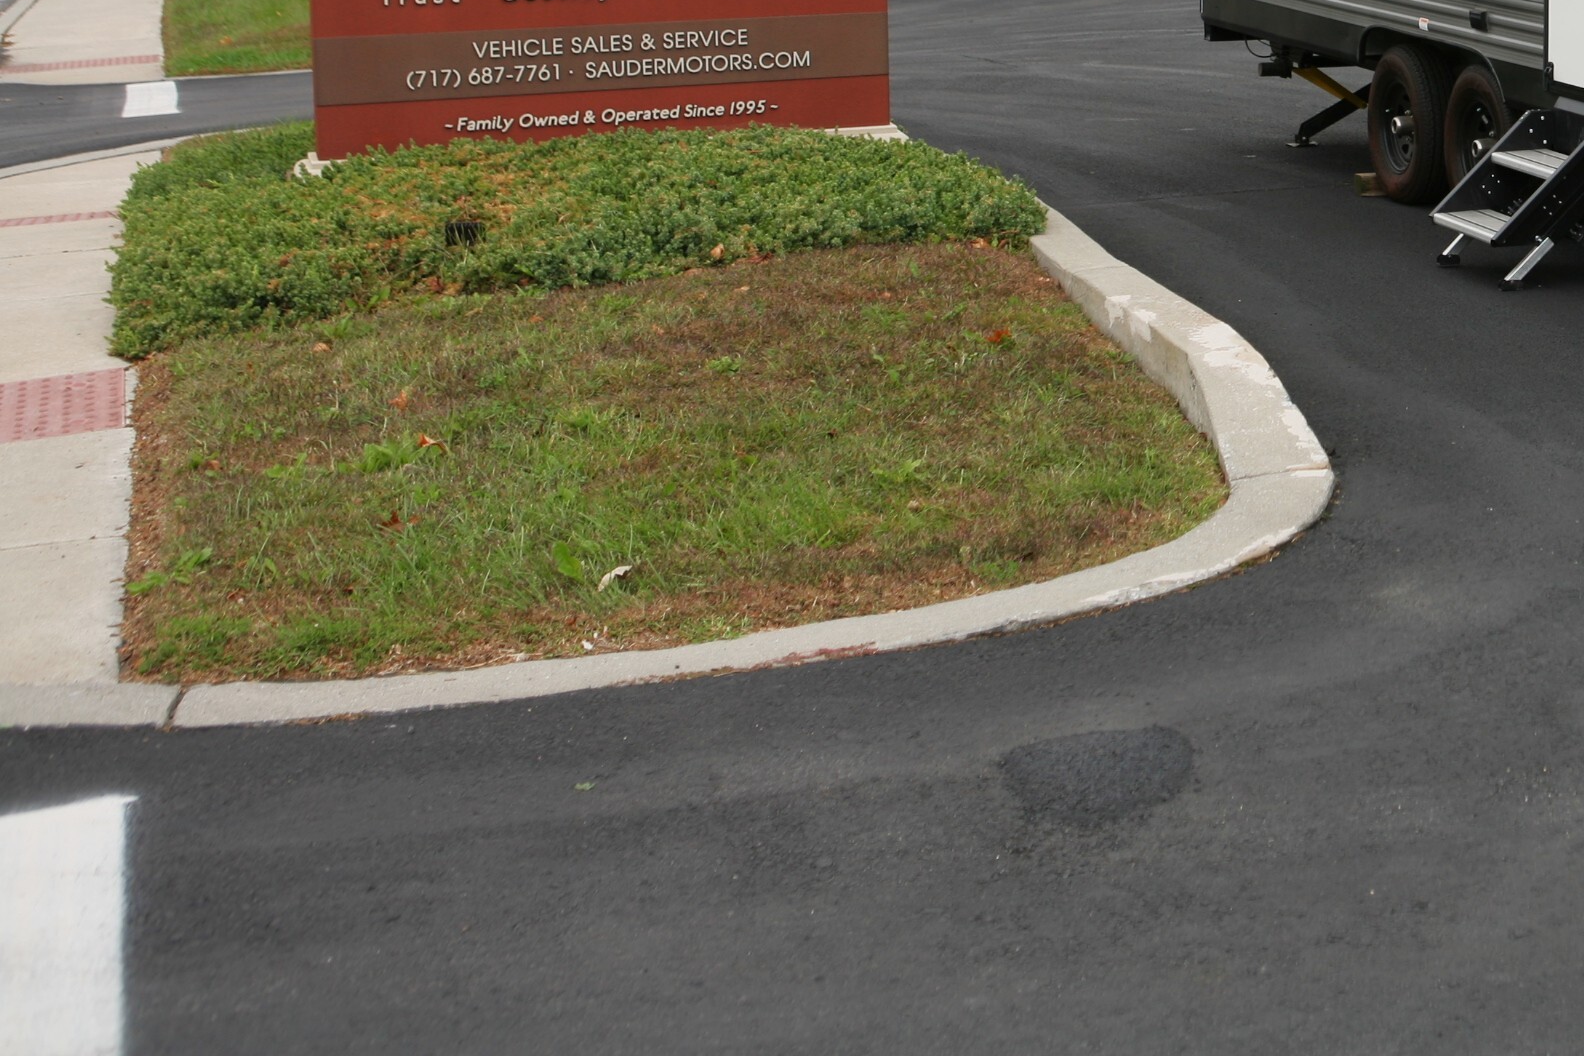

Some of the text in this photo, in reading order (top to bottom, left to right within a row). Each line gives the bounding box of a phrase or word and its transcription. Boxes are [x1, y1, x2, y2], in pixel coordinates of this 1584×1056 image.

[472, 28, 749, 59] VEHICLE SALES & SERVICE
[406, 51, 811, 90] (717) 687-7761 SAUDERMOTORS.COM
[456, 99, 767, 132] Family Owned & Operated Since 1995
